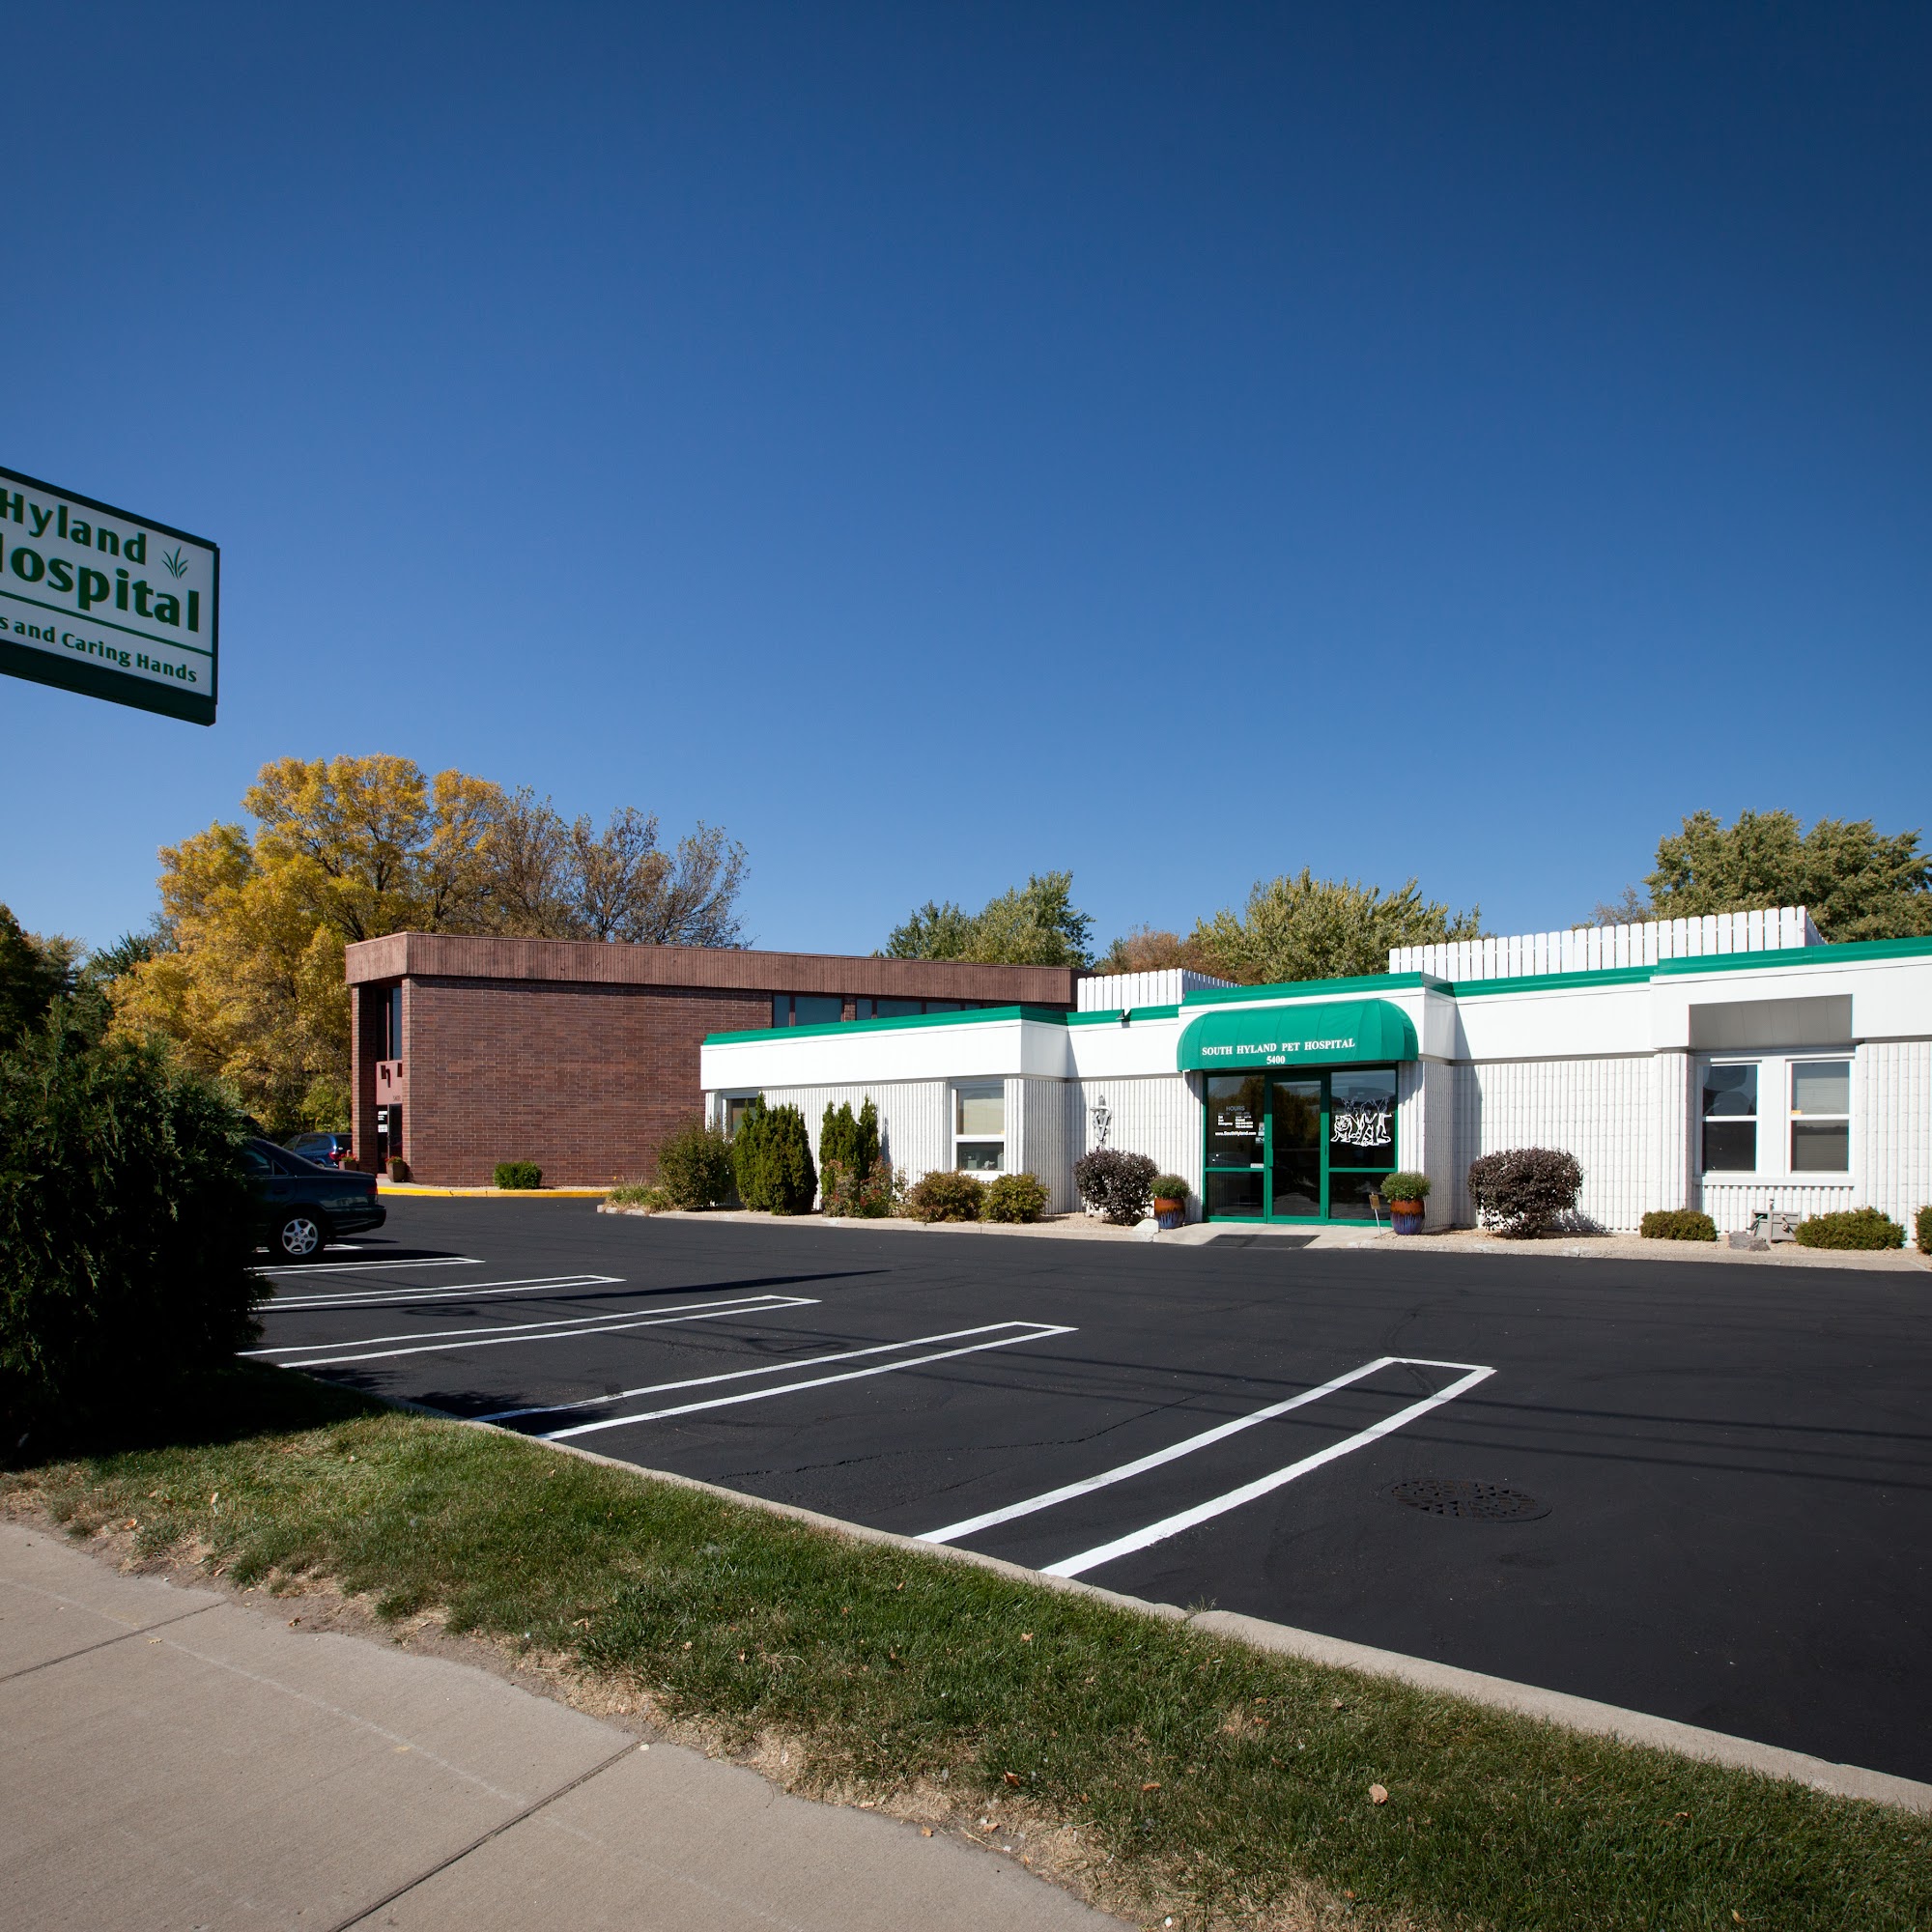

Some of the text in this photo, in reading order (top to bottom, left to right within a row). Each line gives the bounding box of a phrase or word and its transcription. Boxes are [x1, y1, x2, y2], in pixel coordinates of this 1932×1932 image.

[0, 487, 146, 566] Hyland
[0, 532, 199, 634] ospital
[14, 620, 56, 643] and
[62, 633, 131, 668] Caring
[136, 653, 197, 683] Hands
[1202, 1038, 1355, 1056] SOUTH HYLAND PET HOSPITAL
[1266, 1055, 1286, 1065] 5400
